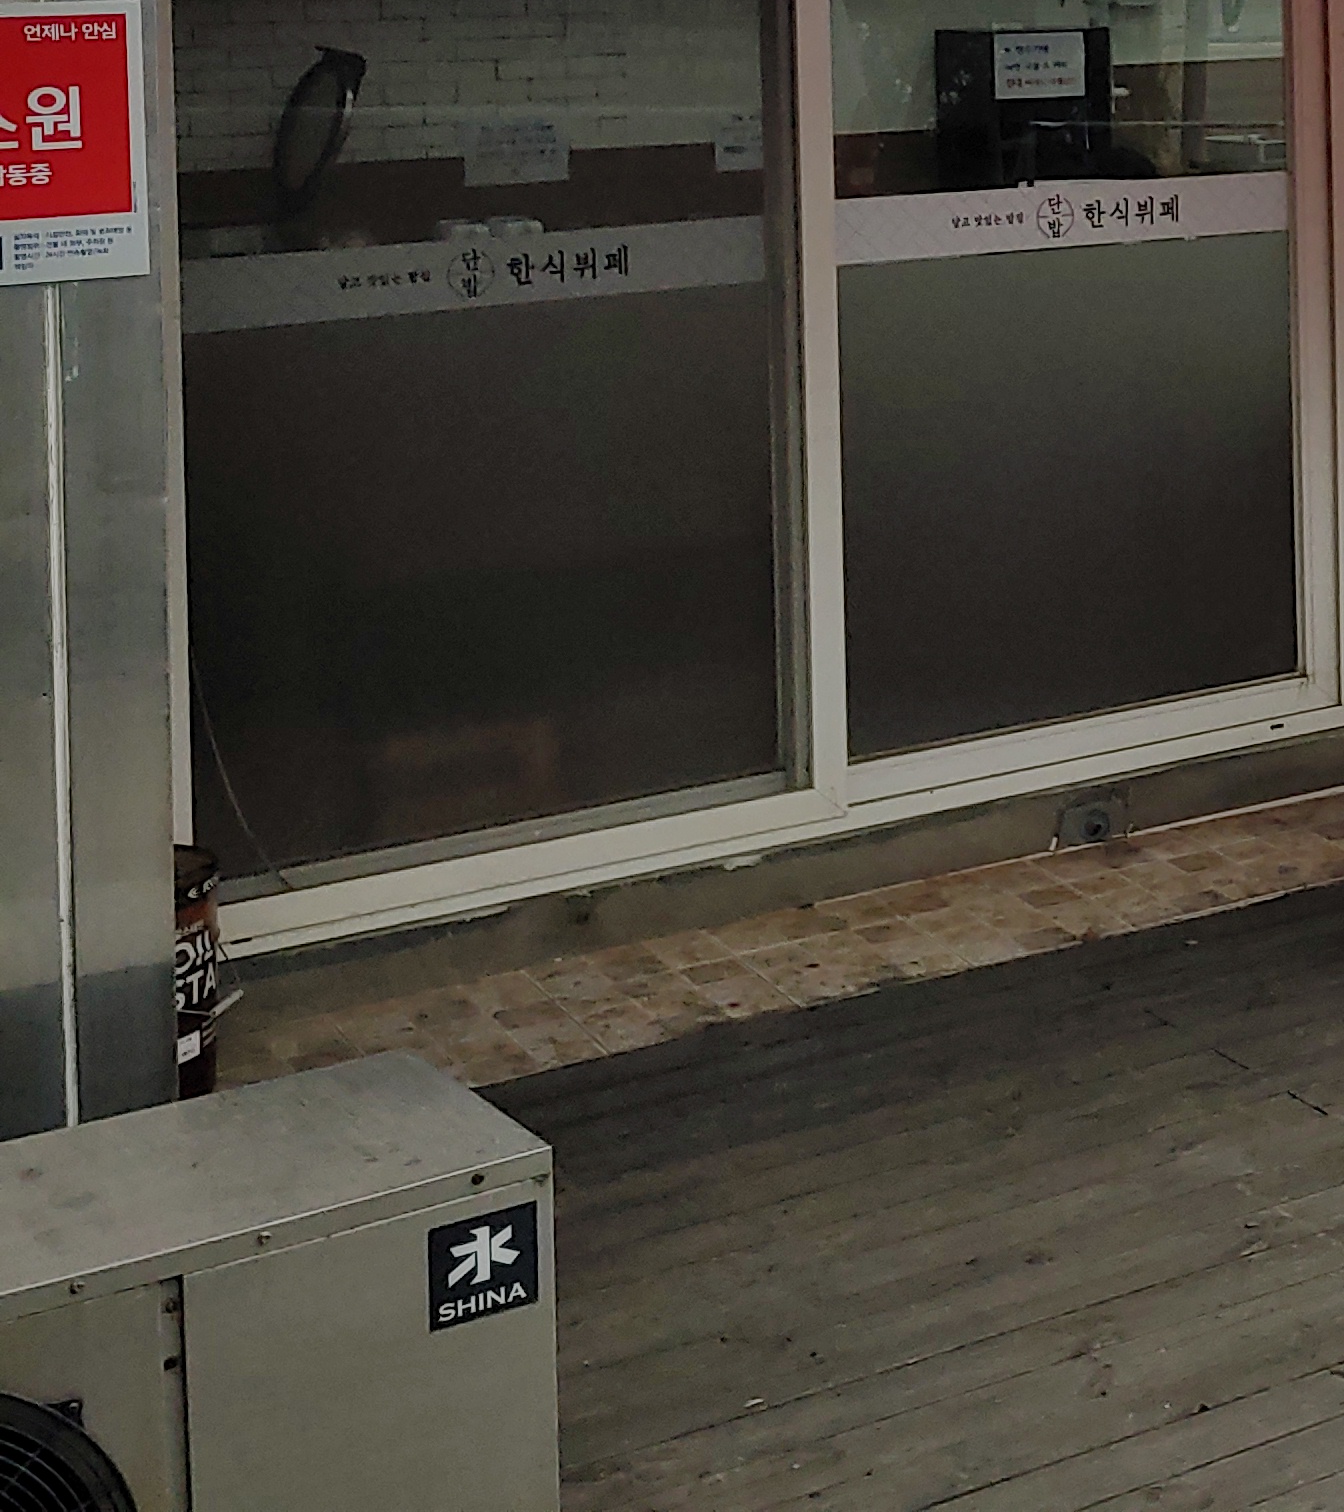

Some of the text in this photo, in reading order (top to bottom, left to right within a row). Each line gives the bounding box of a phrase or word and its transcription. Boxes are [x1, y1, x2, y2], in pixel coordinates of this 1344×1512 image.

[23, 21, 118, 41] 언제나 안심
[1082, 194, 1180, 229] 한식뷔페
[507, 245, 630, 286] 한식뷔페
[437, 1281, 528, 1323] SHINA
